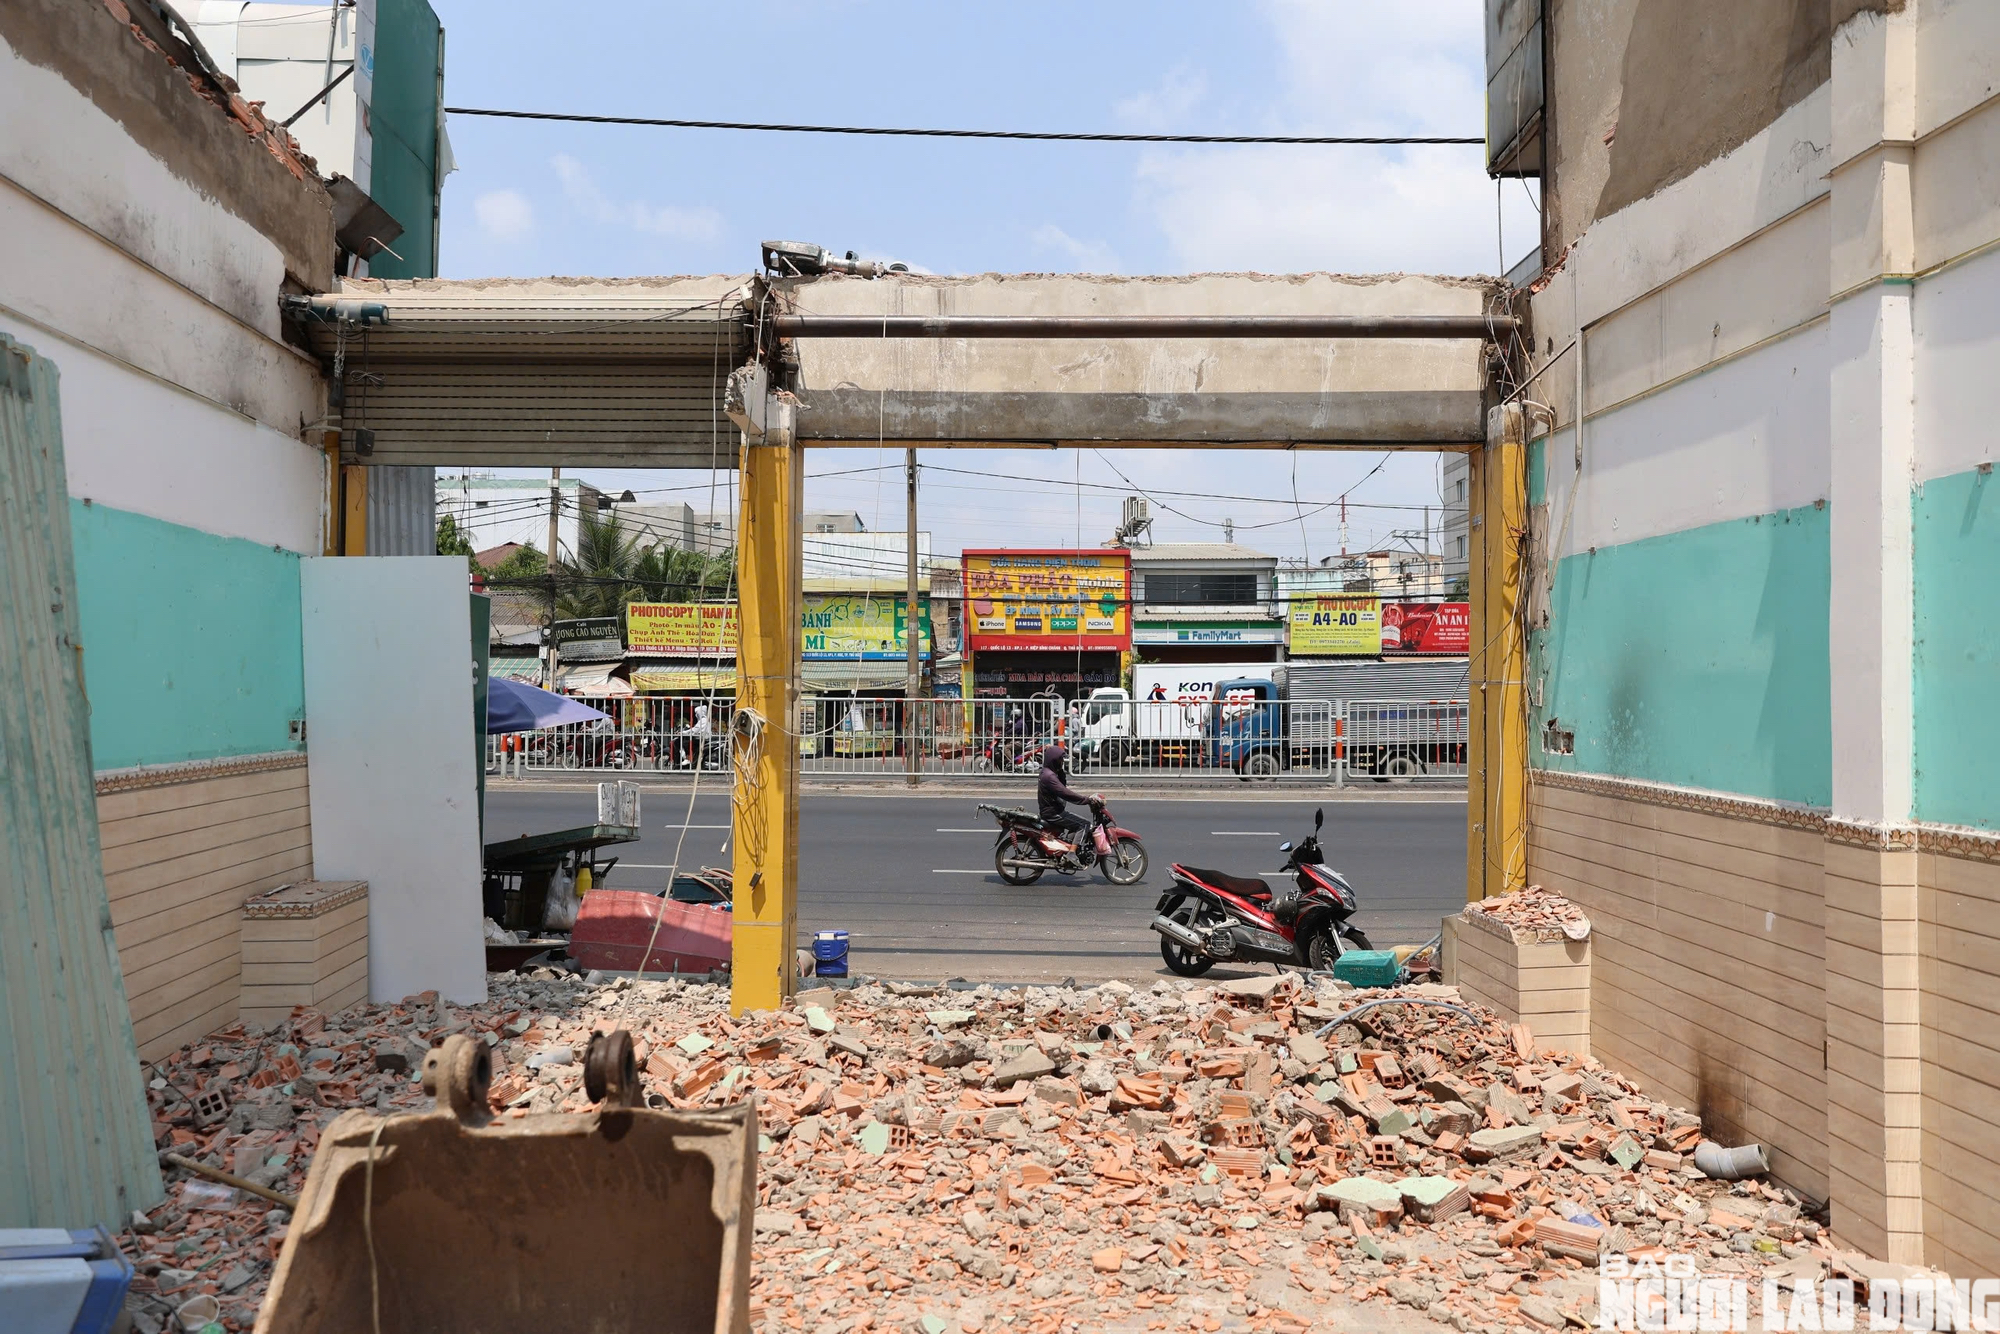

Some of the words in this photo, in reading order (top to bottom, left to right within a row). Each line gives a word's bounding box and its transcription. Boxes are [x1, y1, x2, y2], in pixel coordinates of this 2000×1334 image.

[971, 570, 1013, 589] HÒA
[1018, 568, 1073, 589] PHÁT
[1075, 575, 1122, 589] Mobile
[1316, 595, 1377, 611] PHOTOCOPY
[630, 605, 694, 618] PHOTOCOPY
[649, 621, 670, 629] Photo
[801, 609, 832, 628] BÁNH
[555, 627, 575, 640] ƯƠNG
[575, 627, 589, 637] CAO
[590, 624, 618, 636] NGUYÊN
[629, 629, 649, 637] Chụp
[1192, 630, 1242, 641] FamilyMart
[805, 631, 826, 650] MÌ
[1008, 672, 1027, 682] MUA
[1177, 694, 1256, 707] EXPESS
